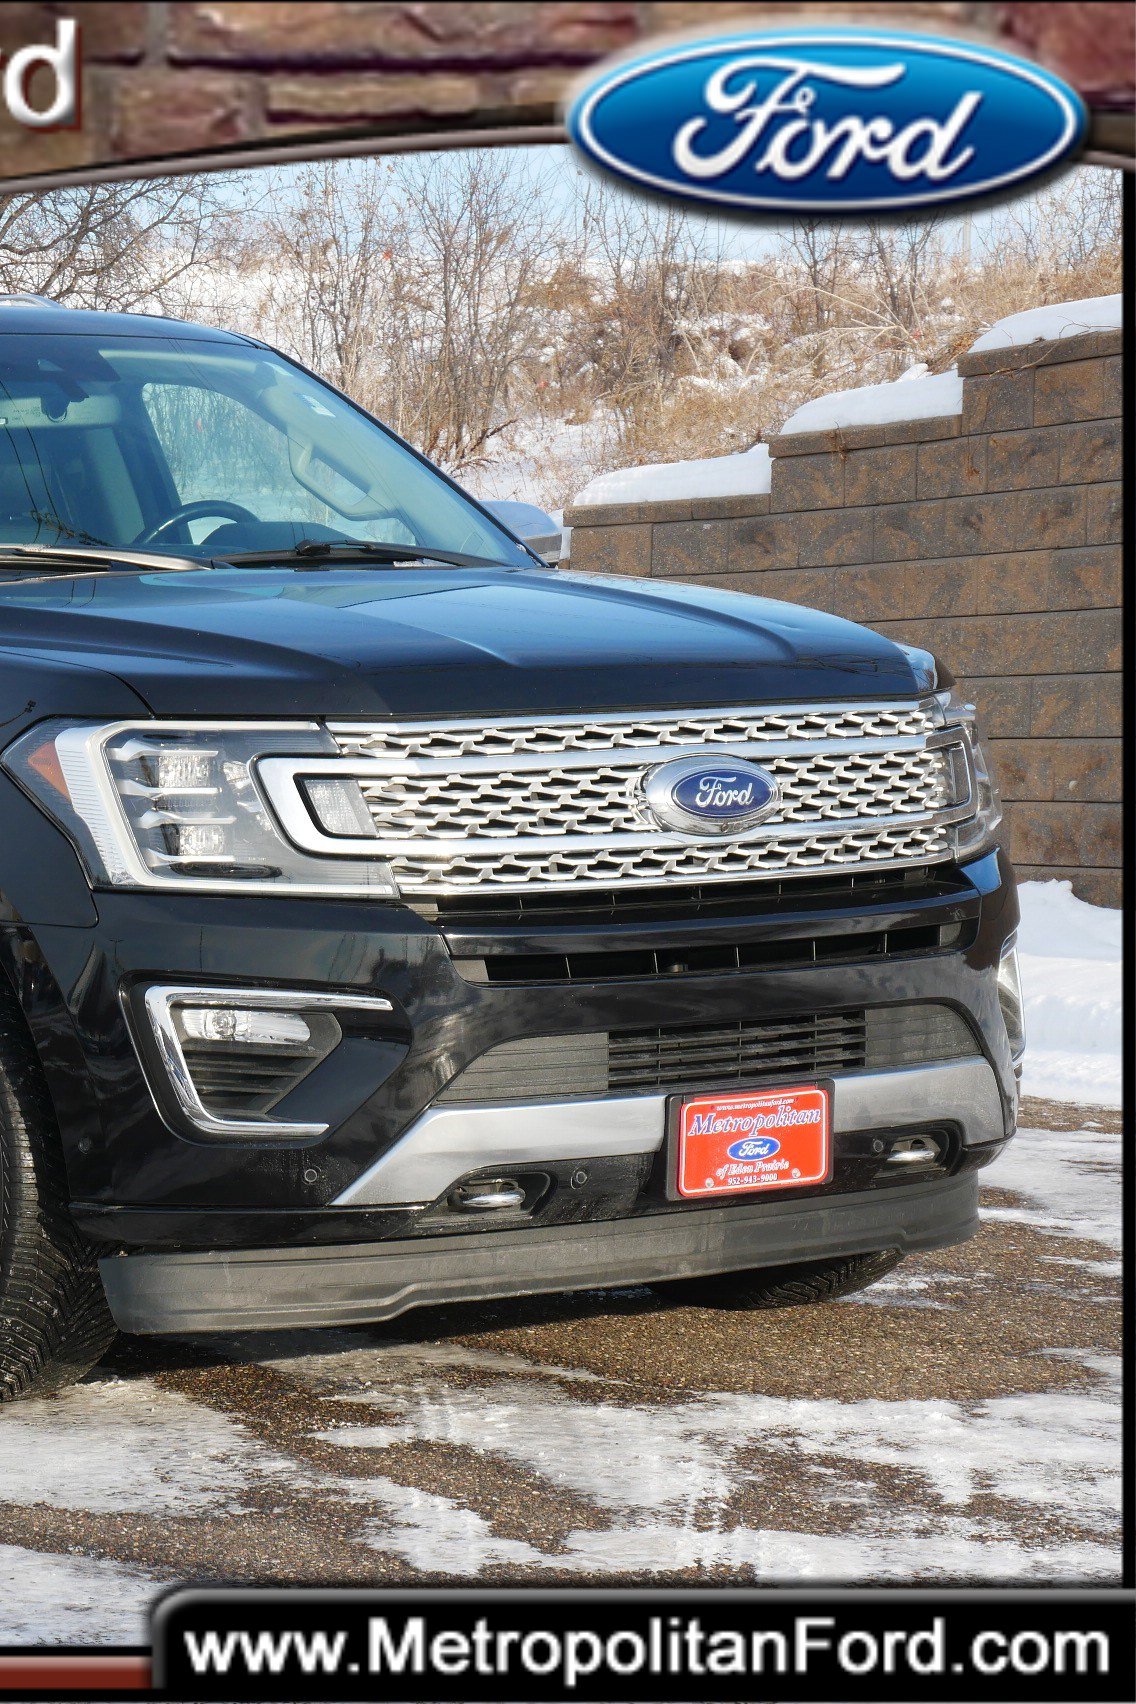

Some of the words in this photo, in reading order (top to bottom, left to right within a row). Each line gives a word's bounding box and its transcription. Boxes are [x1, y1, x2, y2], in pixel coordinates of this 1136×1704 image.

[695, 776, 755, 808] Ford
[688, 1106, 821, 1136] Metropolitan
[739, 1140, 771, 1157] Ford
[716, 1163, 730, 1180] of
[728, 1163, 754, 1175] Eden
[754, 1158, 790, 1173] Prairie
